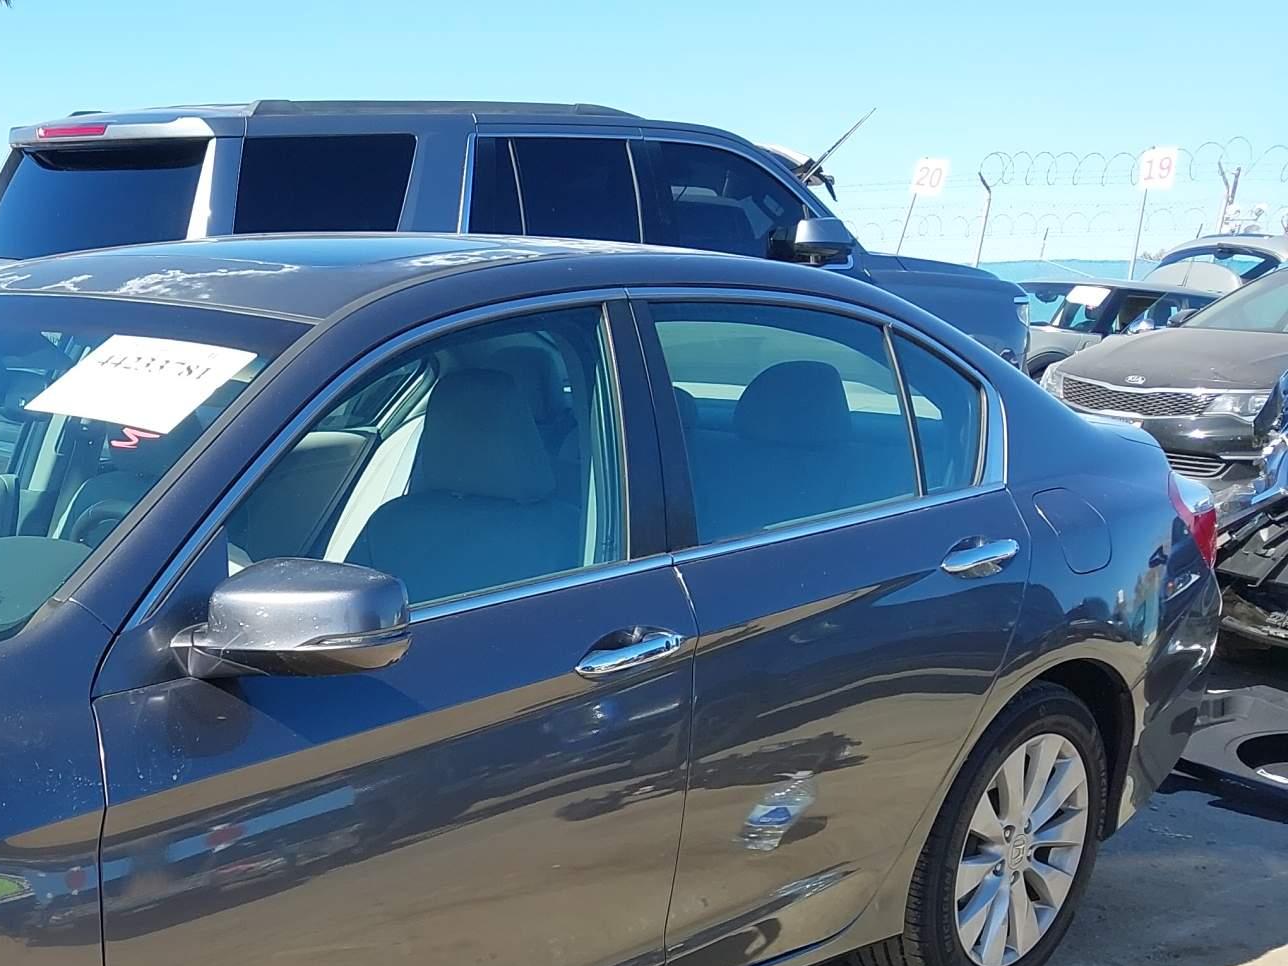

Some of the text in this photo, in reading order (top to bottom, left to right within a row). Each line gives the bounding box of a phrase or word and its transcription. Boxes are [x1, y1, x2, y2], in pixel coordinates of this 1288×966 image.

[915, 166, 943, 188] 20
[1142, 157, 1173, 181] 19
[1125, 375, 1146, 385] KIA
